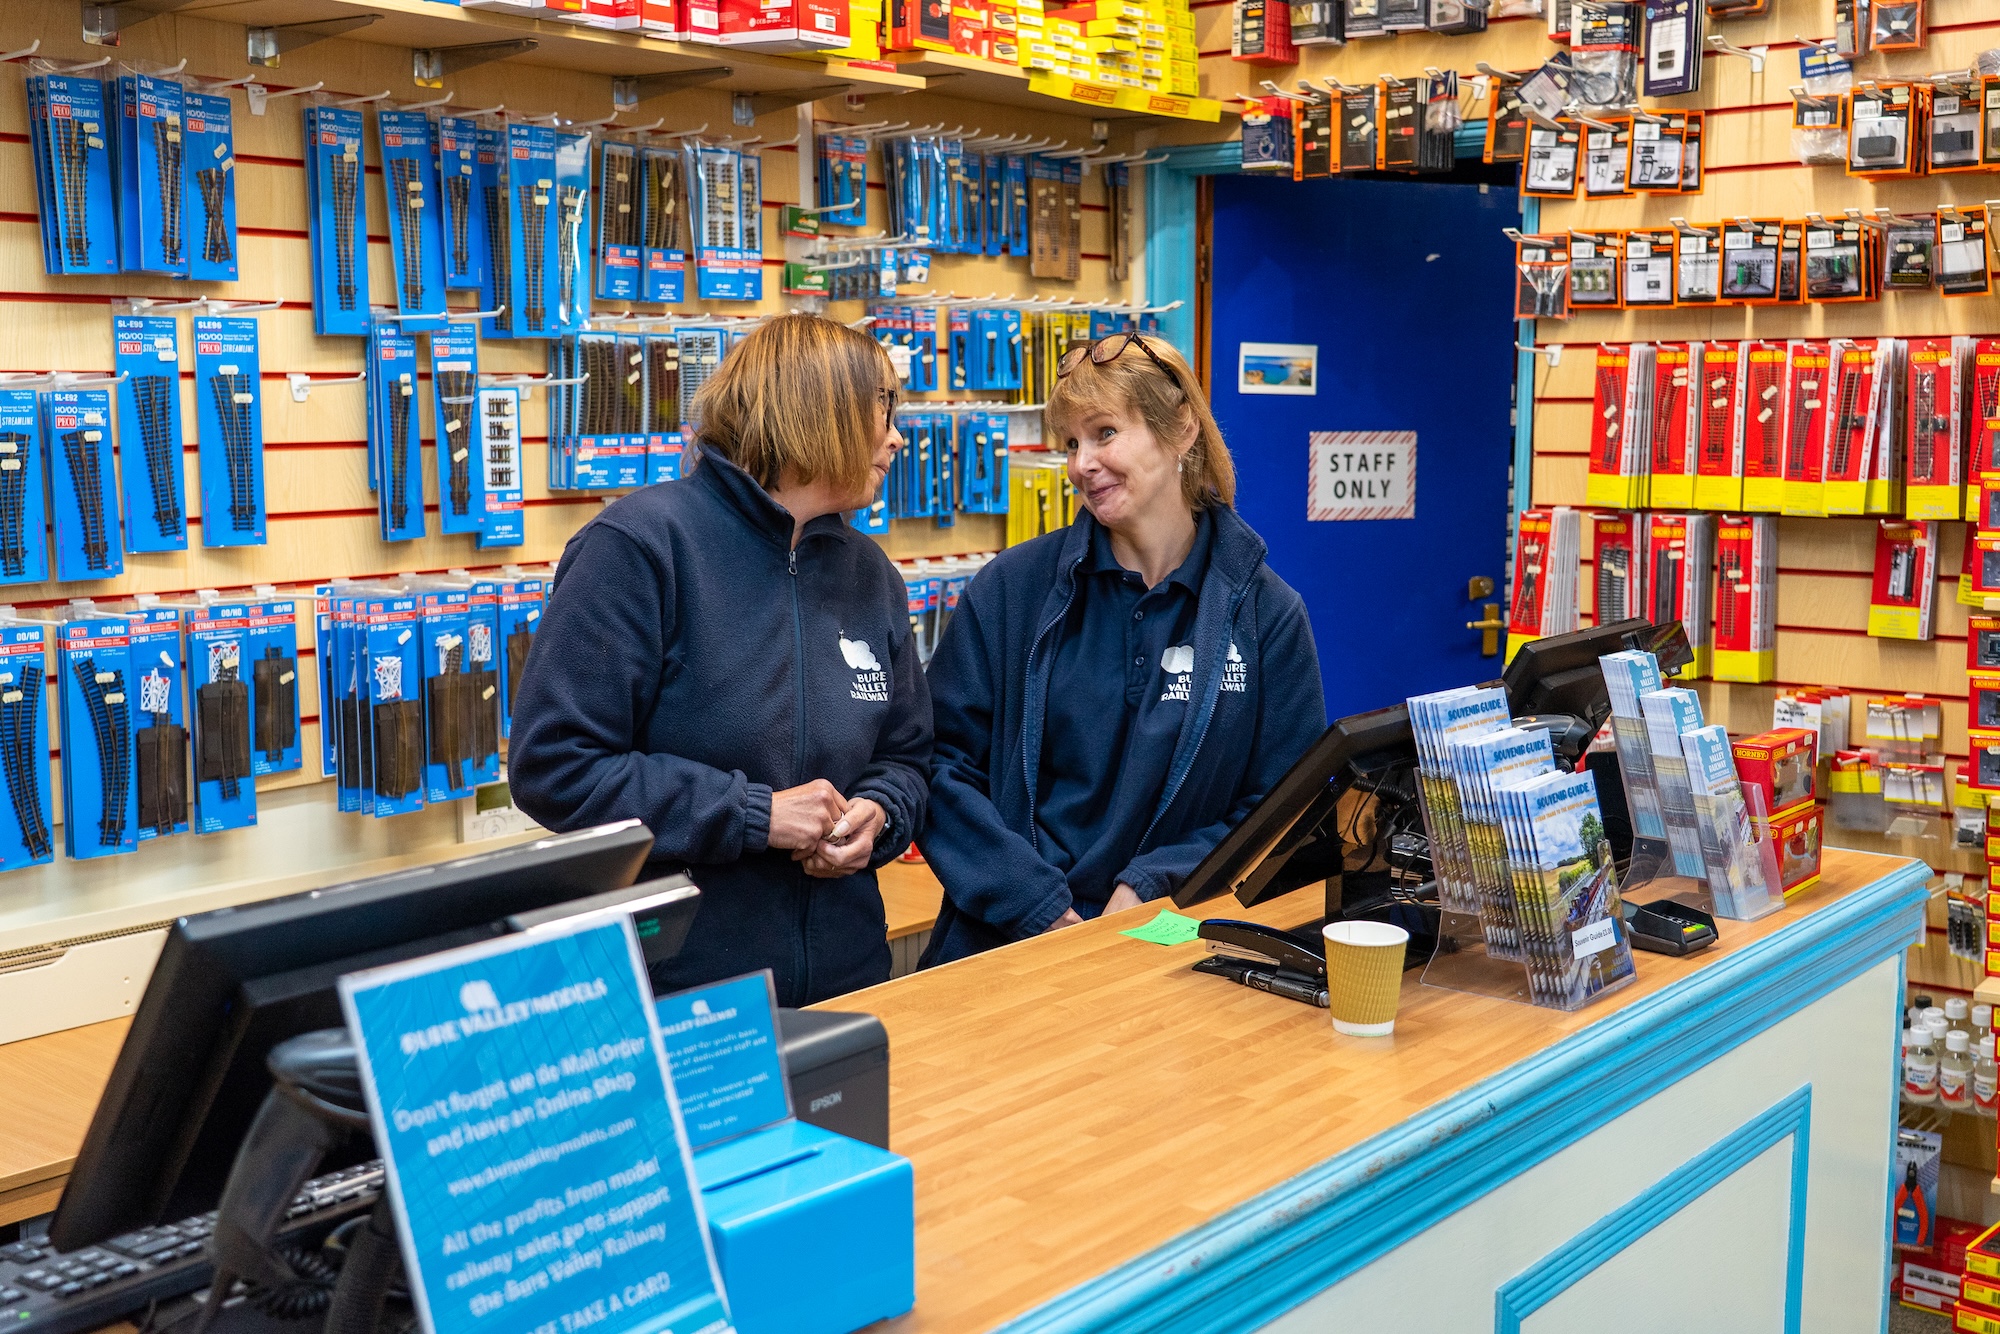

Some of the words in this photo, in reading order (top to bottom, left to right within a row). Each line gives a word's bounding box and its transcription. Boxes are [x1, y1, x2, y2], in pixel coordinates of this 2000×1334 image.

[49, 81, 67, 90] SL-91
[53, 105, 70, 117] PECO
[72, 108, 100, 118] STREAMLINE
[142, 103, 156, 116] PECO
[189, 120, 204, 131] PECO
[386, 135, 402, 146] PECO
[118, 320, 143, 328] SL-E95
[120, 343, 141, 353] PECO
[201, 344, 221, 353] PECO
[223, 345, 254, 353] STREAMLINE
[1706, 352, 1737, 362] HORNBY
[1752, 352, 1786, 361] HORNBY
[1795, 357, 1828, 367] HORNBY
[54, 394, 78, 402] SL-E92
[2, 417, 33, 426] STREAMLINE
[57, 417, 75, 427] PECO
[1330, 453, 1395, 472] STAFF
[1333, 479, 1391, 499] ONLY
[221, 608, 242, 617] OO/HO
[274, 604, 292, 613] OO/HO
[156, 611, 175, 621] OO/HO
[194, 622, 216, 630] SETRACK
[249, 617, 268, 626] SETRACK
[71, 629, 87, 637] PECO
[101, 625, 124, 634] OO/HO
[130, 625, 150, 634] SETRACK
[16, 631, 39, 641] OO/HO
[70, 640, 94, 649] SETRACK
[71, 651, 93, 659] ST245
[1225, 663, 1247, 673] URE
[1641, 668, 1653, 677] BURE
[856, 672, 887, 683] BURE
[1222, 673, 1247, 683] LLEY
[1640, 677, 1656, 687] VALLEY
[852, 682, 888, 693] VALLEY
[1220, 683, 1247, 692] LWAY
[850, 690, 889, 701] RAILWAY
[1161, 692, 1190, 702] RAIL
[1448, 702, 1480, 721] SOUVENIR
[1480, 698, 1502, 712] GUIDE
[1684, 705, 1696, 715] BURE
[1682, 714, 1697, 724] VALLEY
[1494, 744, 1526, 762] SOUVENIR
[1526, 739, 1547, 753] GUIDE
[1711, 743, 1723, 753] BURE
[1709, 752, 1725, 762] VALLEY
[1736, 750, 1767, 759] HORNBY
[1536, 791, 1567, 809] SOUVENIR
[1568, 783, 1590, 798] GUIDE
[1574, 937, 1590, 947] Souvenir
[1590, 931, 1603, 942] Guide
[401, 1018, 459, 1055] BURE
[461, 998, 530, 1038] VALLEY
[531, 977, 608, 1015] MODELS
[661, 1019, 694, 1037] ALLEY
[753, 1035, 767, 1047] and
[394, 1095, 450, 1134] Don't
[450, 1080, 509, 1116] forget
[509, 1072, 536, 1094] we
[536, 1063, 560, 1084] do
[560, 1048, 600, 1078] Mail
[600, 1036, 646, 1065] Order
[712, 1080, 745, 1095] however
[707, 1087, 754, 1108] appreciated
[810, 1091, 842, 1114] EPSON
[428, 1128, 464, 1157] and
[464, 1112, 508, 1145] have
[509, 1107, 535, 1128] an
[535, 1088, 592, 1120] Online
[593, 1072, 636, 1104] Shop
[698, 1119, 721, 1131] Thank
[723, 1115, 739, 1126] you
[442, 1231, 469, 1257] All
[470, 1220, 503, 1247] the
[505, 1197, 566, 1235] profits
[565, 1184, 608, 1212] from
[609, 1156, 660, 1193] model
[447, 1249, 514, 1291] railway
[515, 1232, 561, 1262] sales
[561, 1222, 586, 1250] go
[584, 1213, 606, 1235] to
[605, 1185, 671, 1228] support
[468, 1291, 505, 1318] the
[504, 1269, 548, 1301] Bure
[546, 1250, 602, 1284] Valley
[603, 1222, 667, 1259] Railway
[560, 1299, 609, 1333] TAKE
[609, 1293, 624, 1313] A
[623, 1271, 671, 1308] CARD
